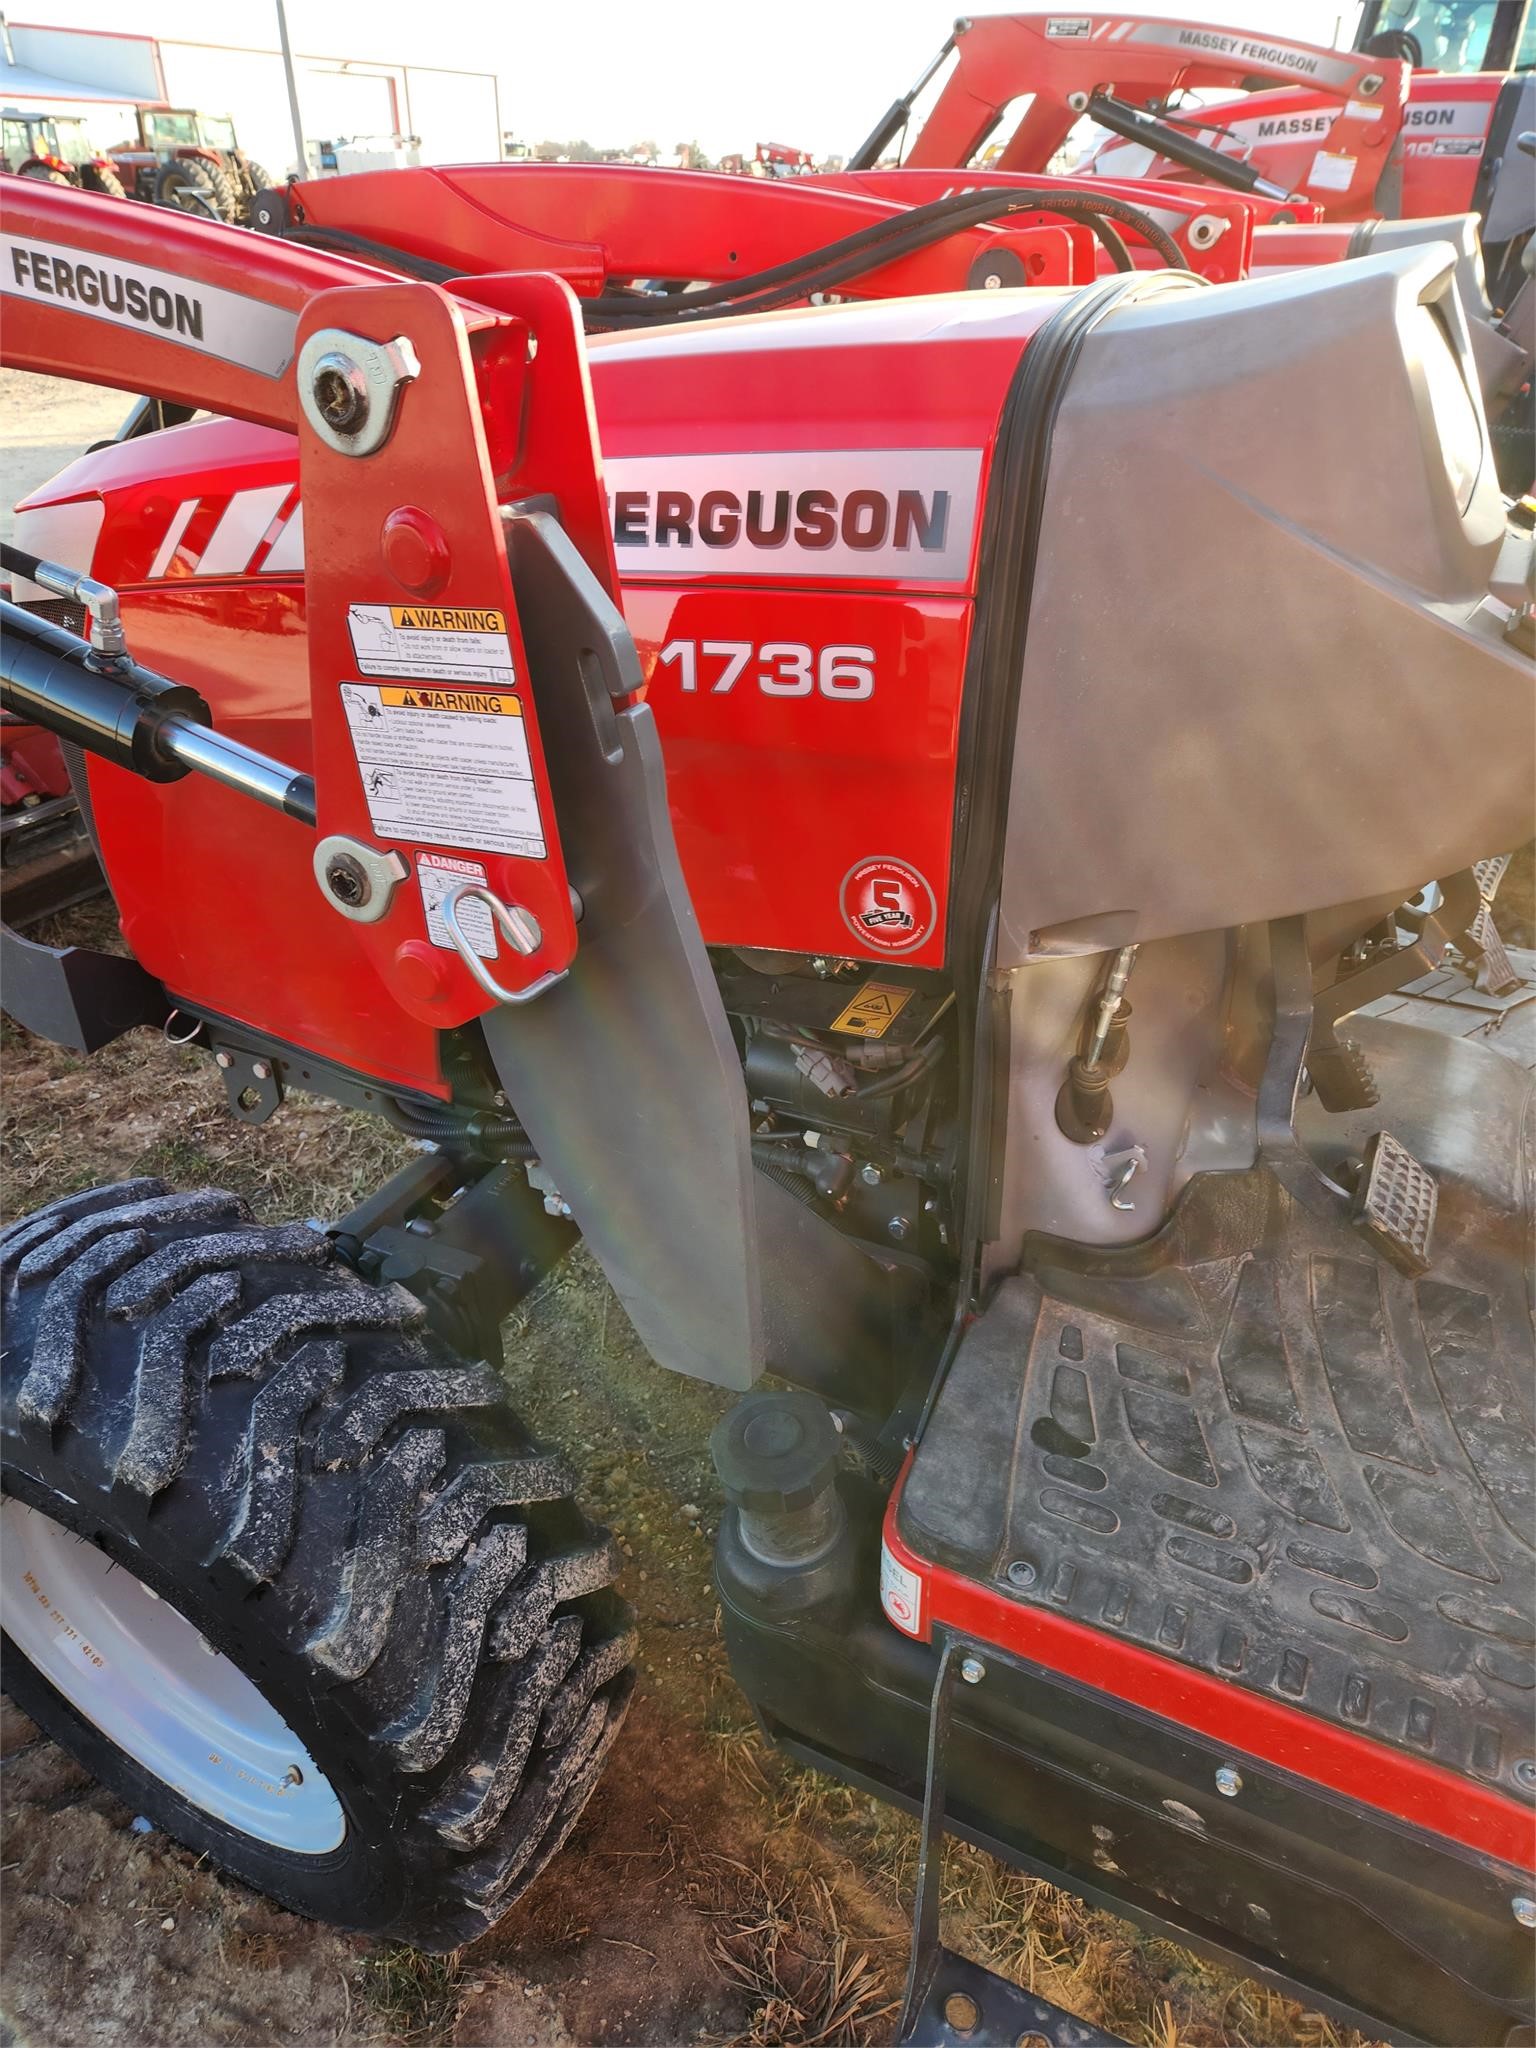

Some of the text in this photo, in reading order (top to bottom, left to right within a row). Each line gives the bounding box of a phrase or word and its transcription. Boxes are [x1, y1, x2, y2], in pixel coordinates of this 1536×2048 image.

[1178, 31, 1318, 75] MASSEY FERGUSON
[11, 246, 204, 342] FERGUSON
[613, 489, 952, 552] ERGUSON
[414, 609, 499, 632] WARNING
[659, 639, 877, 701] 1736
[430, 855, 483, 877] DANGER
[872, 879, 902, 912] 5
[884, 912, 901, 921] YEAR
